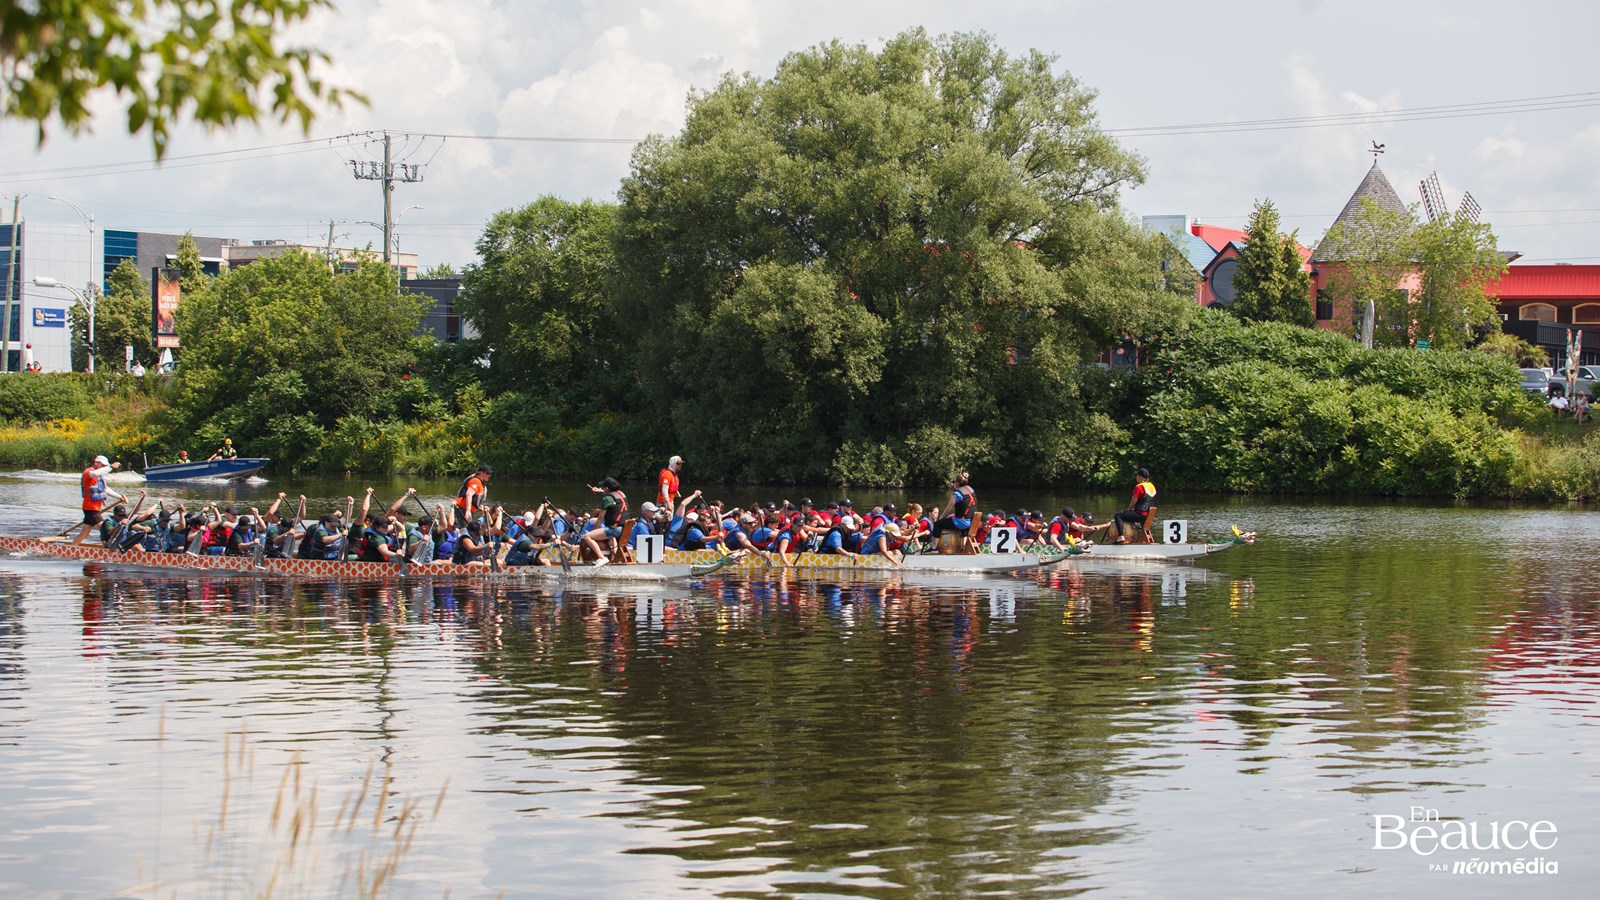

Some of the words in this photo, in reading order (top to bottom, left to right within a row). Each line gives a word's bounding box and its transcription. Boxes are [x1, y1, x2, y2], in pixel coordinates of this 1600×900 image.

[997, 529, 1010, 553] 2
[1169, 521, 1181, 543] 3
[645, 537, 653, 562] 1
